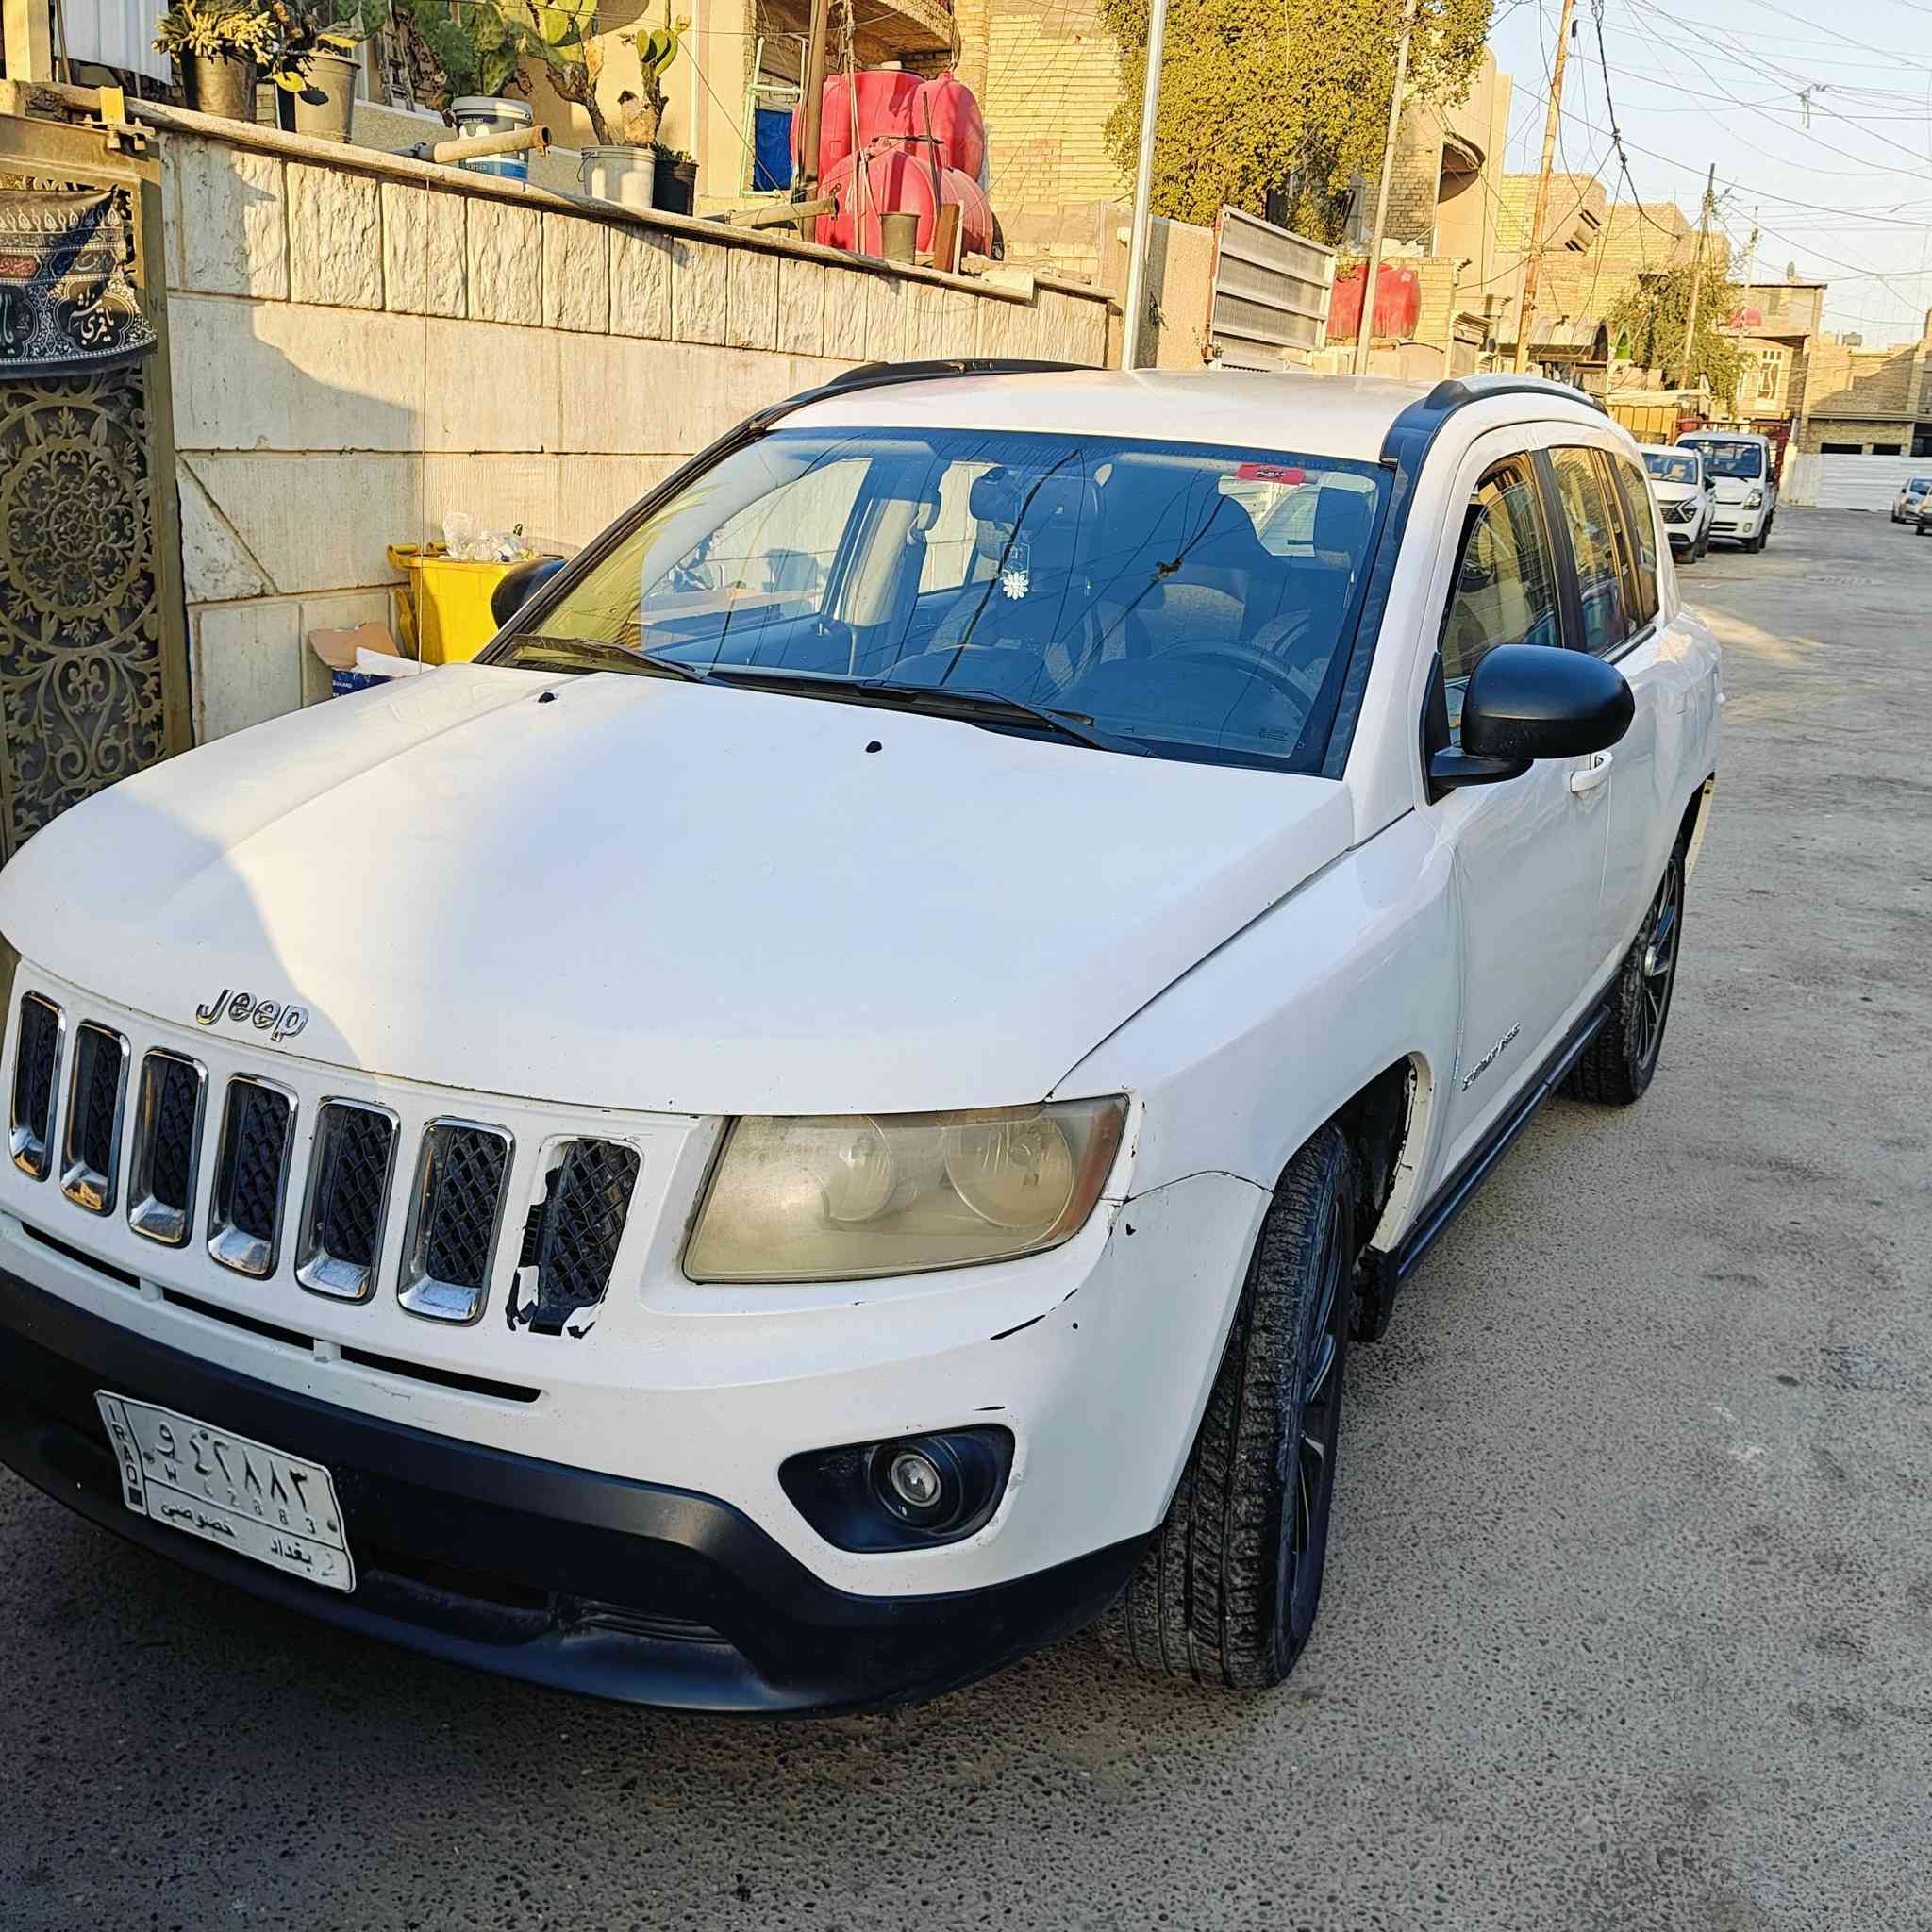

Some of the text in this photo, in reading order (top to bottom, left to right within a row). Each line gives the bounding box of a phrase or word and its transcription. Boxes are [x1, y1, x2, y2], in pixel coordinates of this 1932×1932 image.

[195, 988, 309, 1043] Jeep
[108, 1403, 139, 1486] IRAQ
[270, 1537, 313, 1573] بغداد
